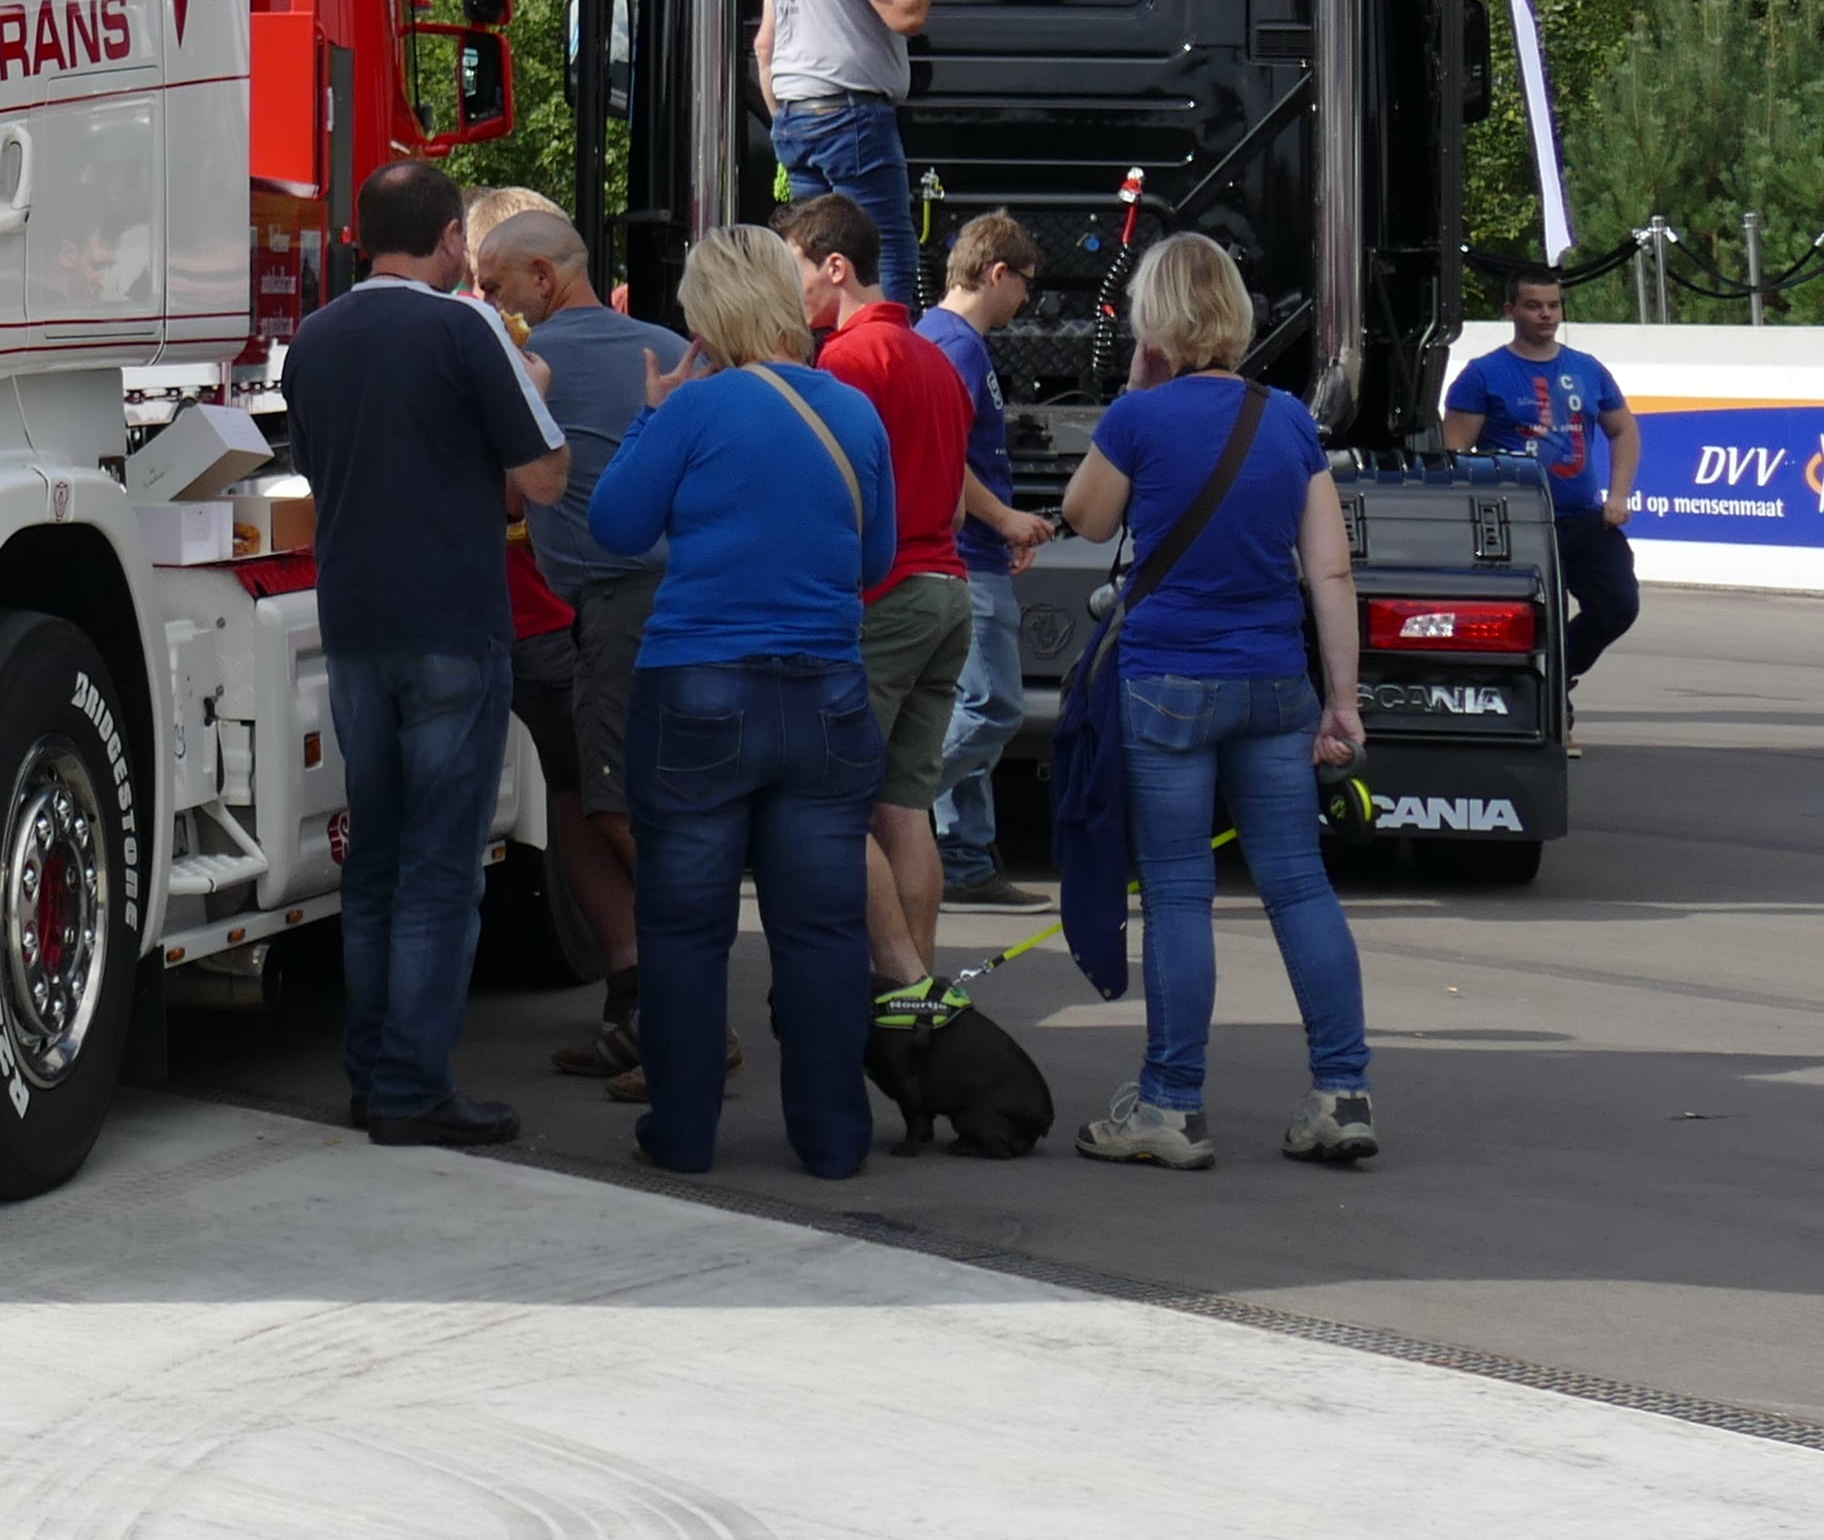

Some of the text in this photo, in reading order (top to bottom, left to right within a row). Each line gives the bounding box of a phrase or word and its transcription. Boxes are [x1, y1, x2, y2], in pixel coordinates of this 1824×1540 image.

[1695, 446, 1786, 486] DVV
[1647, 496, 1669, 517] op
[1674, 497, 1785, 518] mensenmaat
[1356, 683, 1509, 715] SCANIA
[71, 671, 138, 932] BRIDGESTONE
[1368, 795, 1524, 831] CANIA
